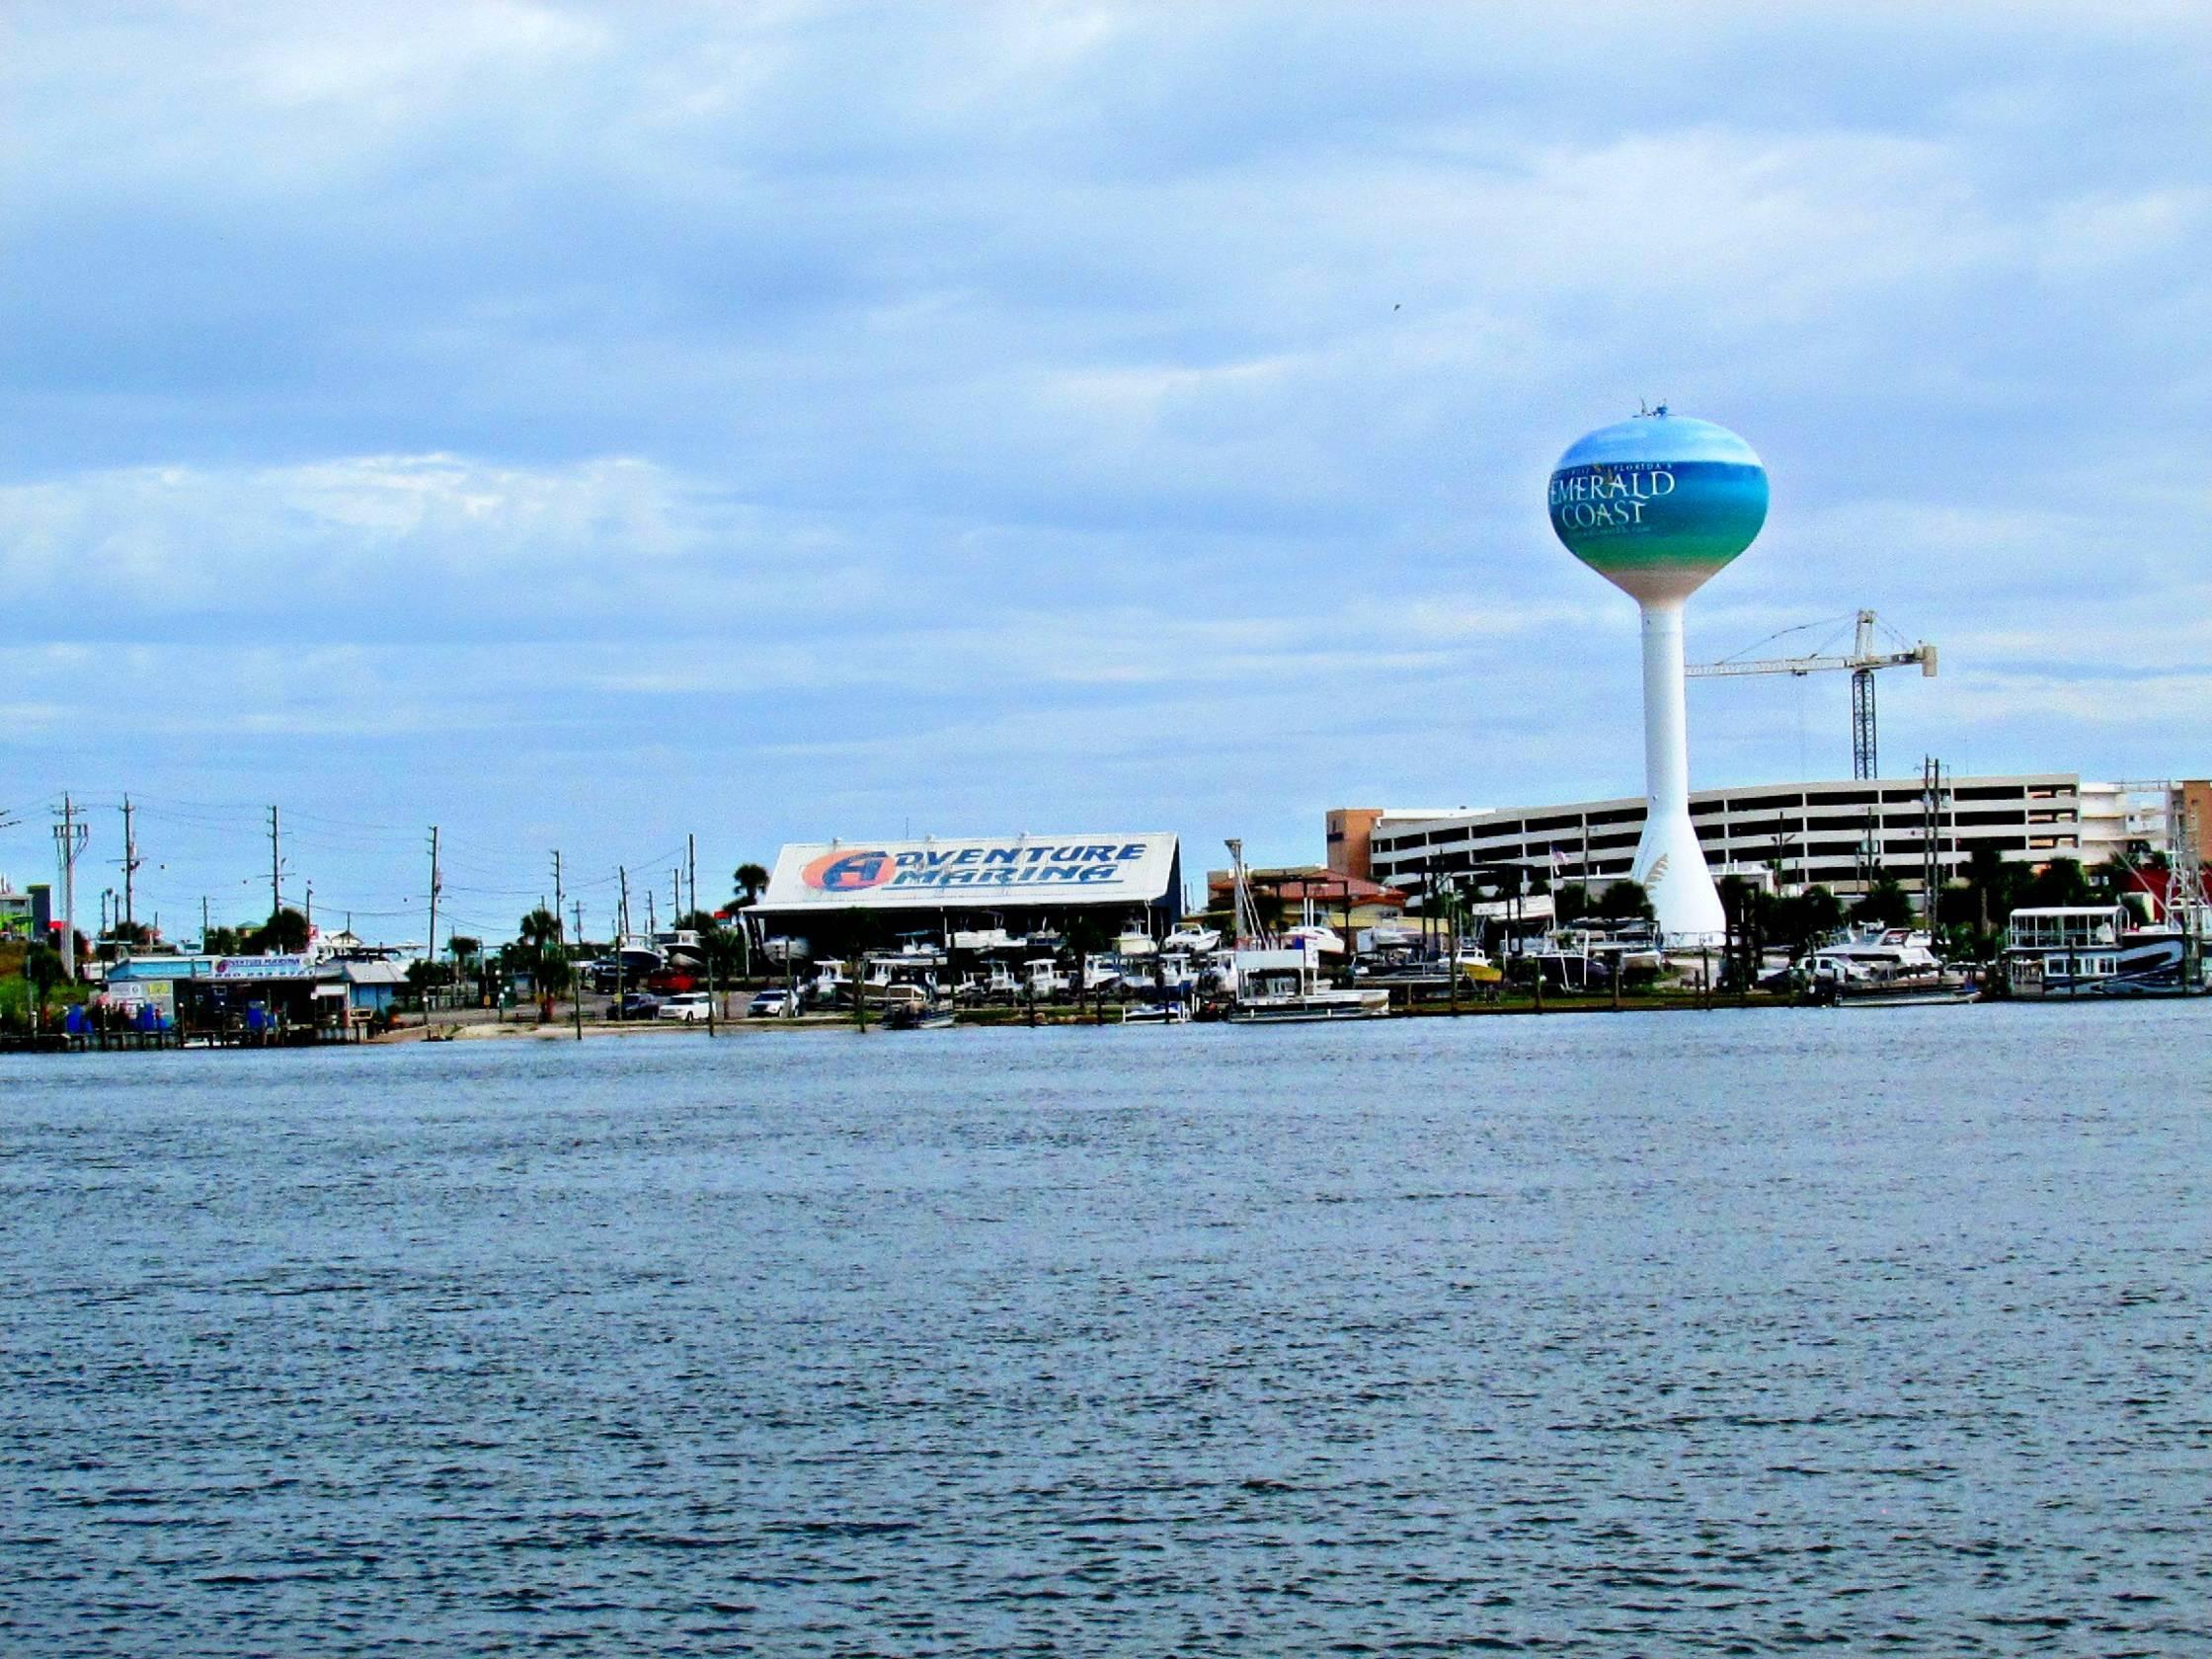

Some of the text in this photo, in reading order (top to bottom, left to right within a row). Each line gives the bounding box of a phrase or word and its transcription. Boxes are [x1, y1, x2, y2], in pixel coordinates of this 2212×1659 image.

[1549, 470, 1676, 505] EMERALD
[1561, 500, 1647, 529] COAST
[892, 864, 1120, 886] MARINA
